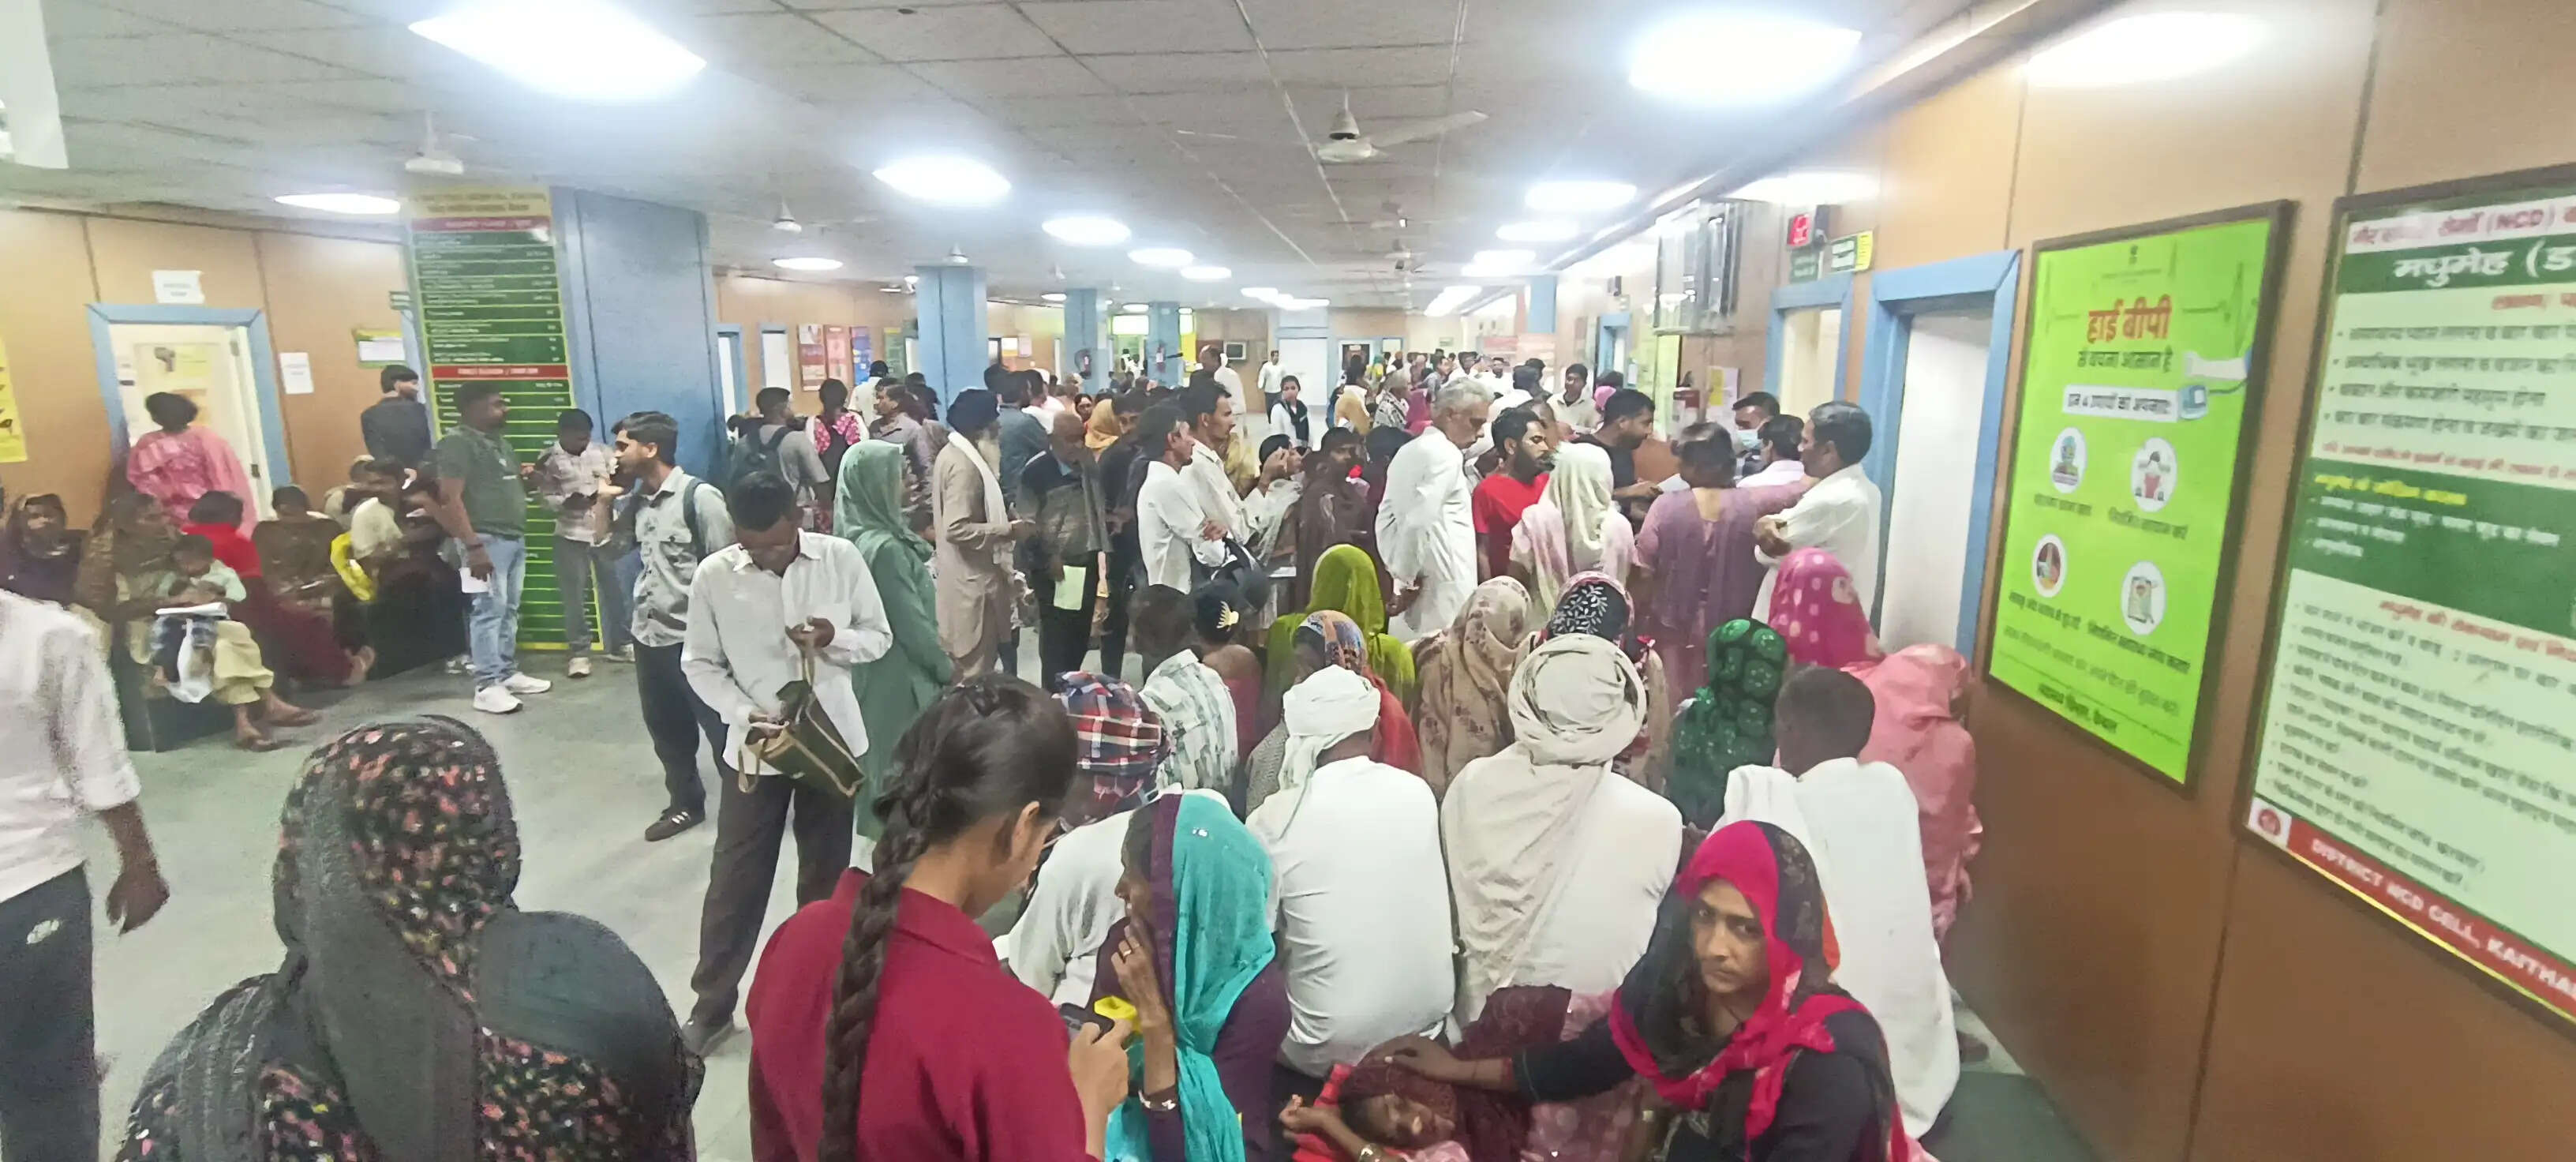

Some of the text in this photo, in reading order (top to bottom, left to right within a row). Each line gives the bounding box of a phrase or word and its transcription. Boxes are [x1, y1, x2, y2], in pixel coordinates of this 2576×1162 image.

[2392, 238, 2576, 288] मधुमेह (ड
[2086, 293, 2172, 343] हाई बीपी
[2088, 350, 2119, 368] बचना
[2121, 350, 2161, 369] आसान
[2161, 344, 2174, 373] है
[2311, 838, 2383, 887] DISTRICT
[2386, 881, 2425, 912] NCD
[2428, 905, 2481, 949] CELL,
